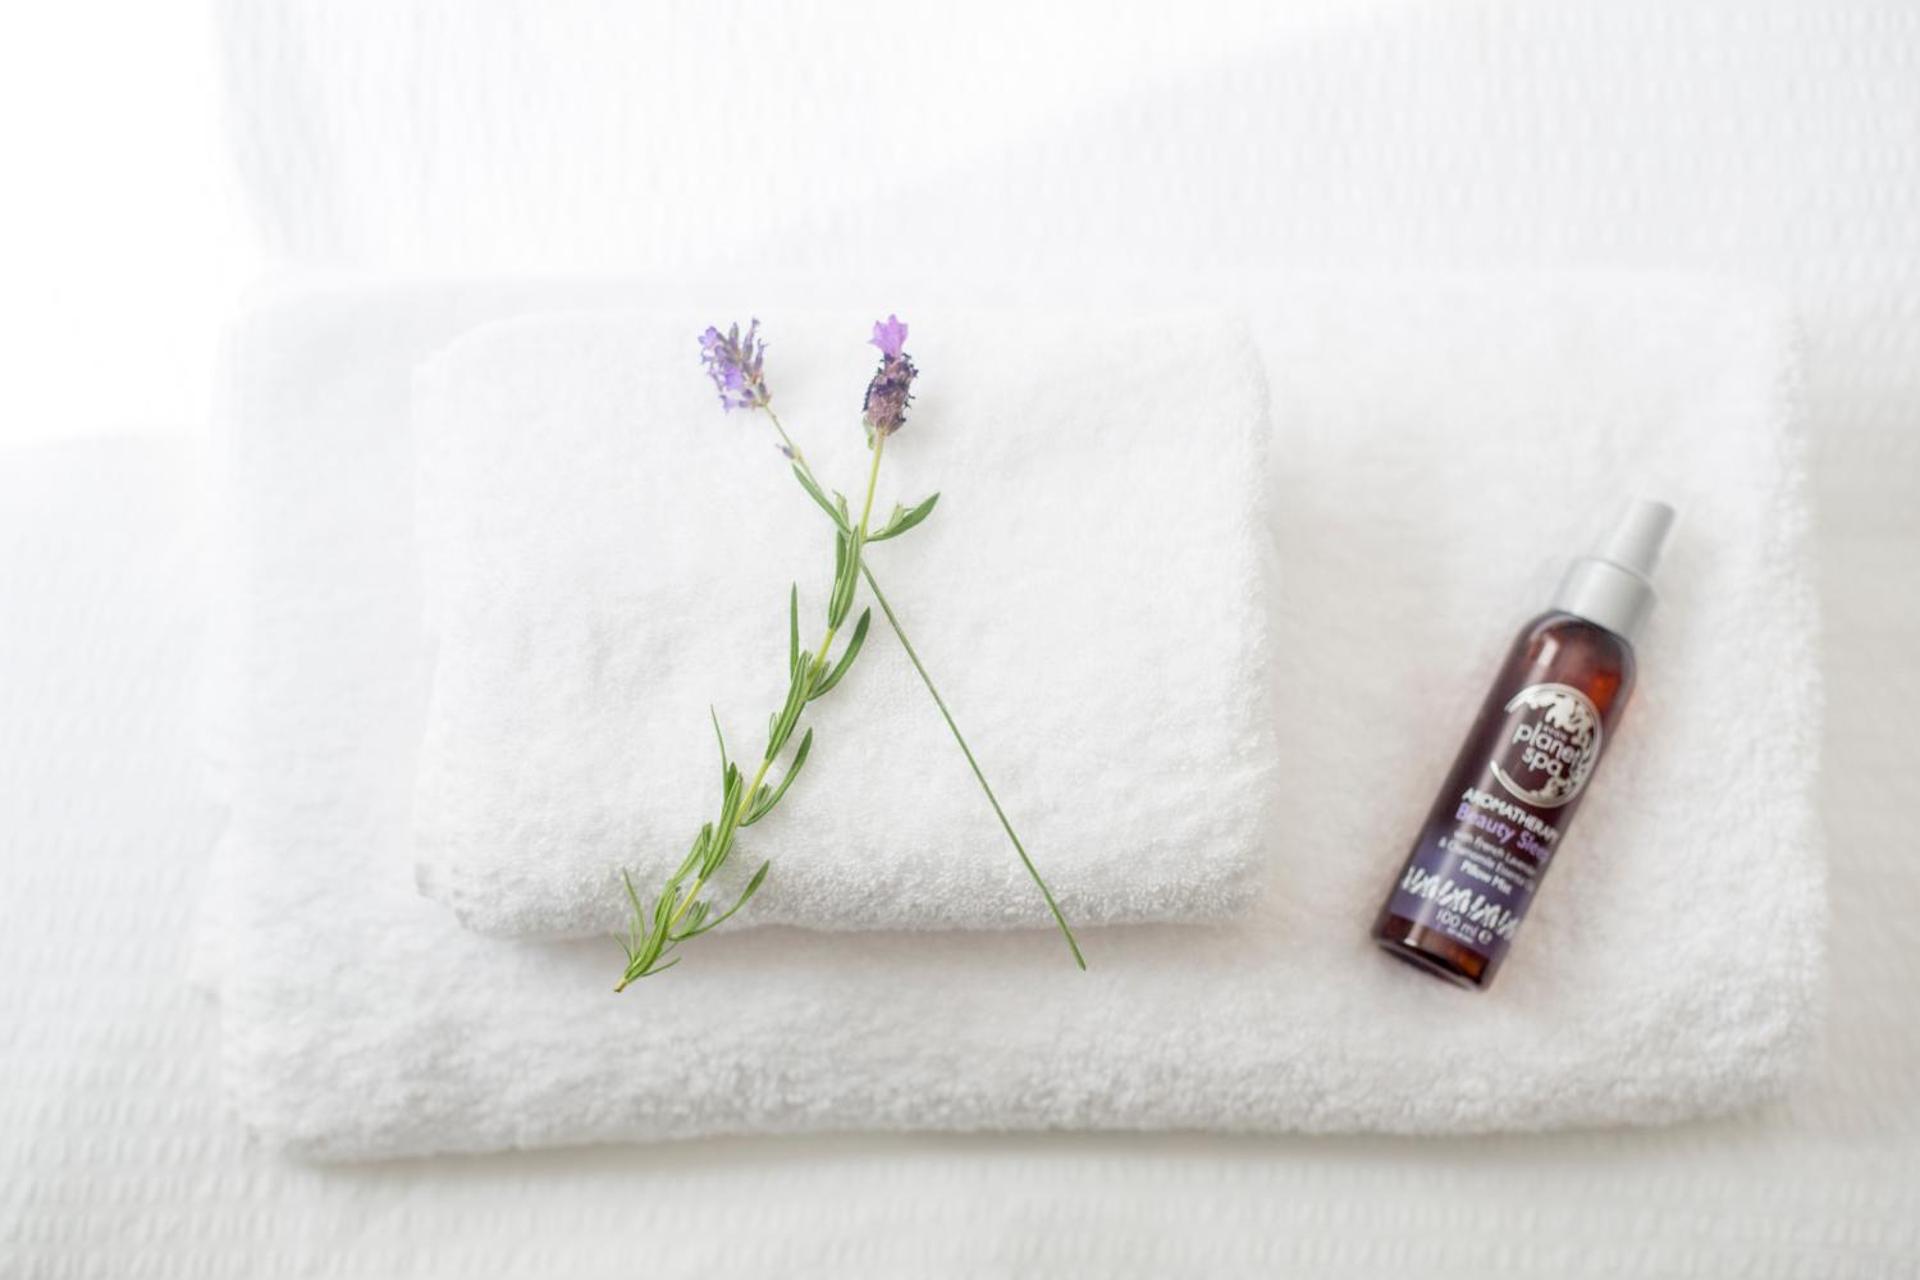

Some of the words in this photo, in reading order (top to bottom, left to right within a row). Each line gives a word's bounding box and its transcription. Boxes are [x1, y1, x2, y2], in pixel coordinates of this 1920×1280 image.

[1512, 721, 1581, 769] planet
[1522, 747, 1562, 777] spa
[1455, 802, 1515, 844] Beauty
[1435, 909, 1461, 927] 100
[1460, 922, 1479, 938] ml
